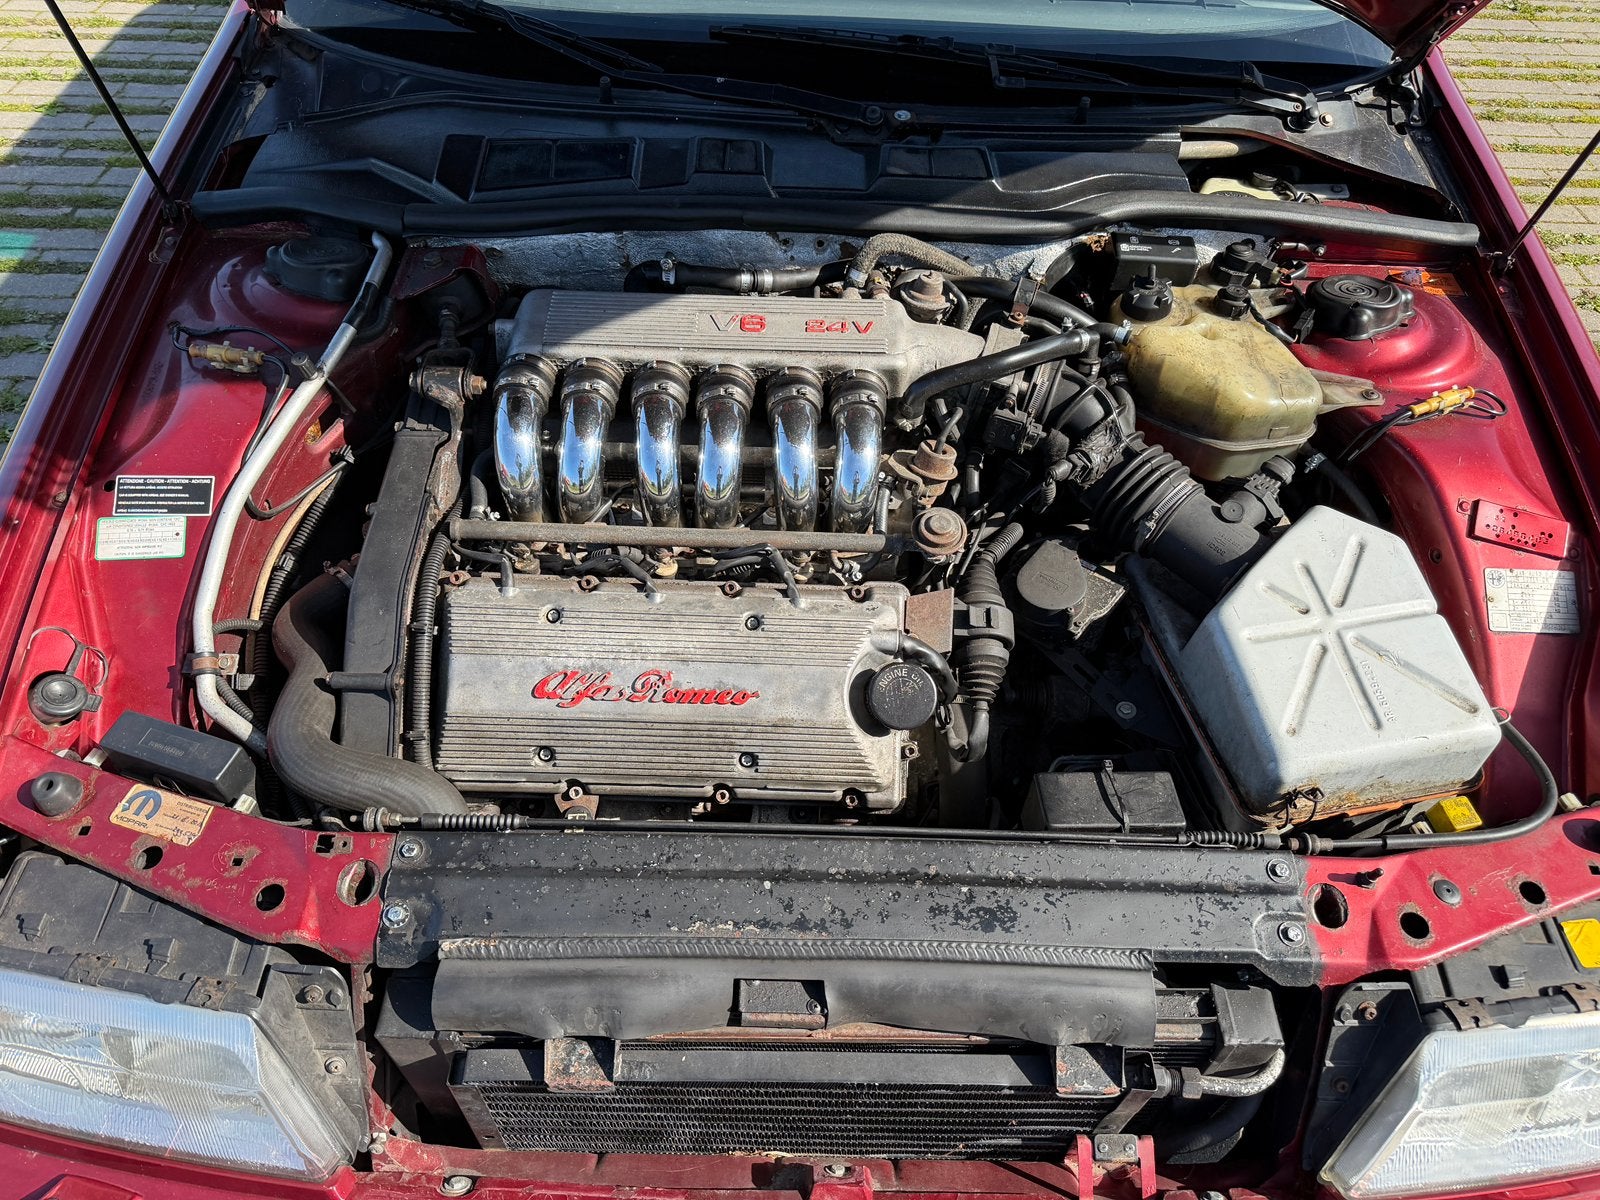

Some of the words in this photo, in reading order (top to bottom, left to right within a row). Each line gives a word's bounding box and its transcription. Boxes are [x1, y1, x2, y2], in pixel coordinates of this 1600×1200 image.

[710, 314, 767, 333] V6
[805, 319, 874, 335] 24V
[531, 669, 627, 707] Alfa
[626, 668, 760, 705] Romeo
[114, 814, 147, 829] MOPAR
